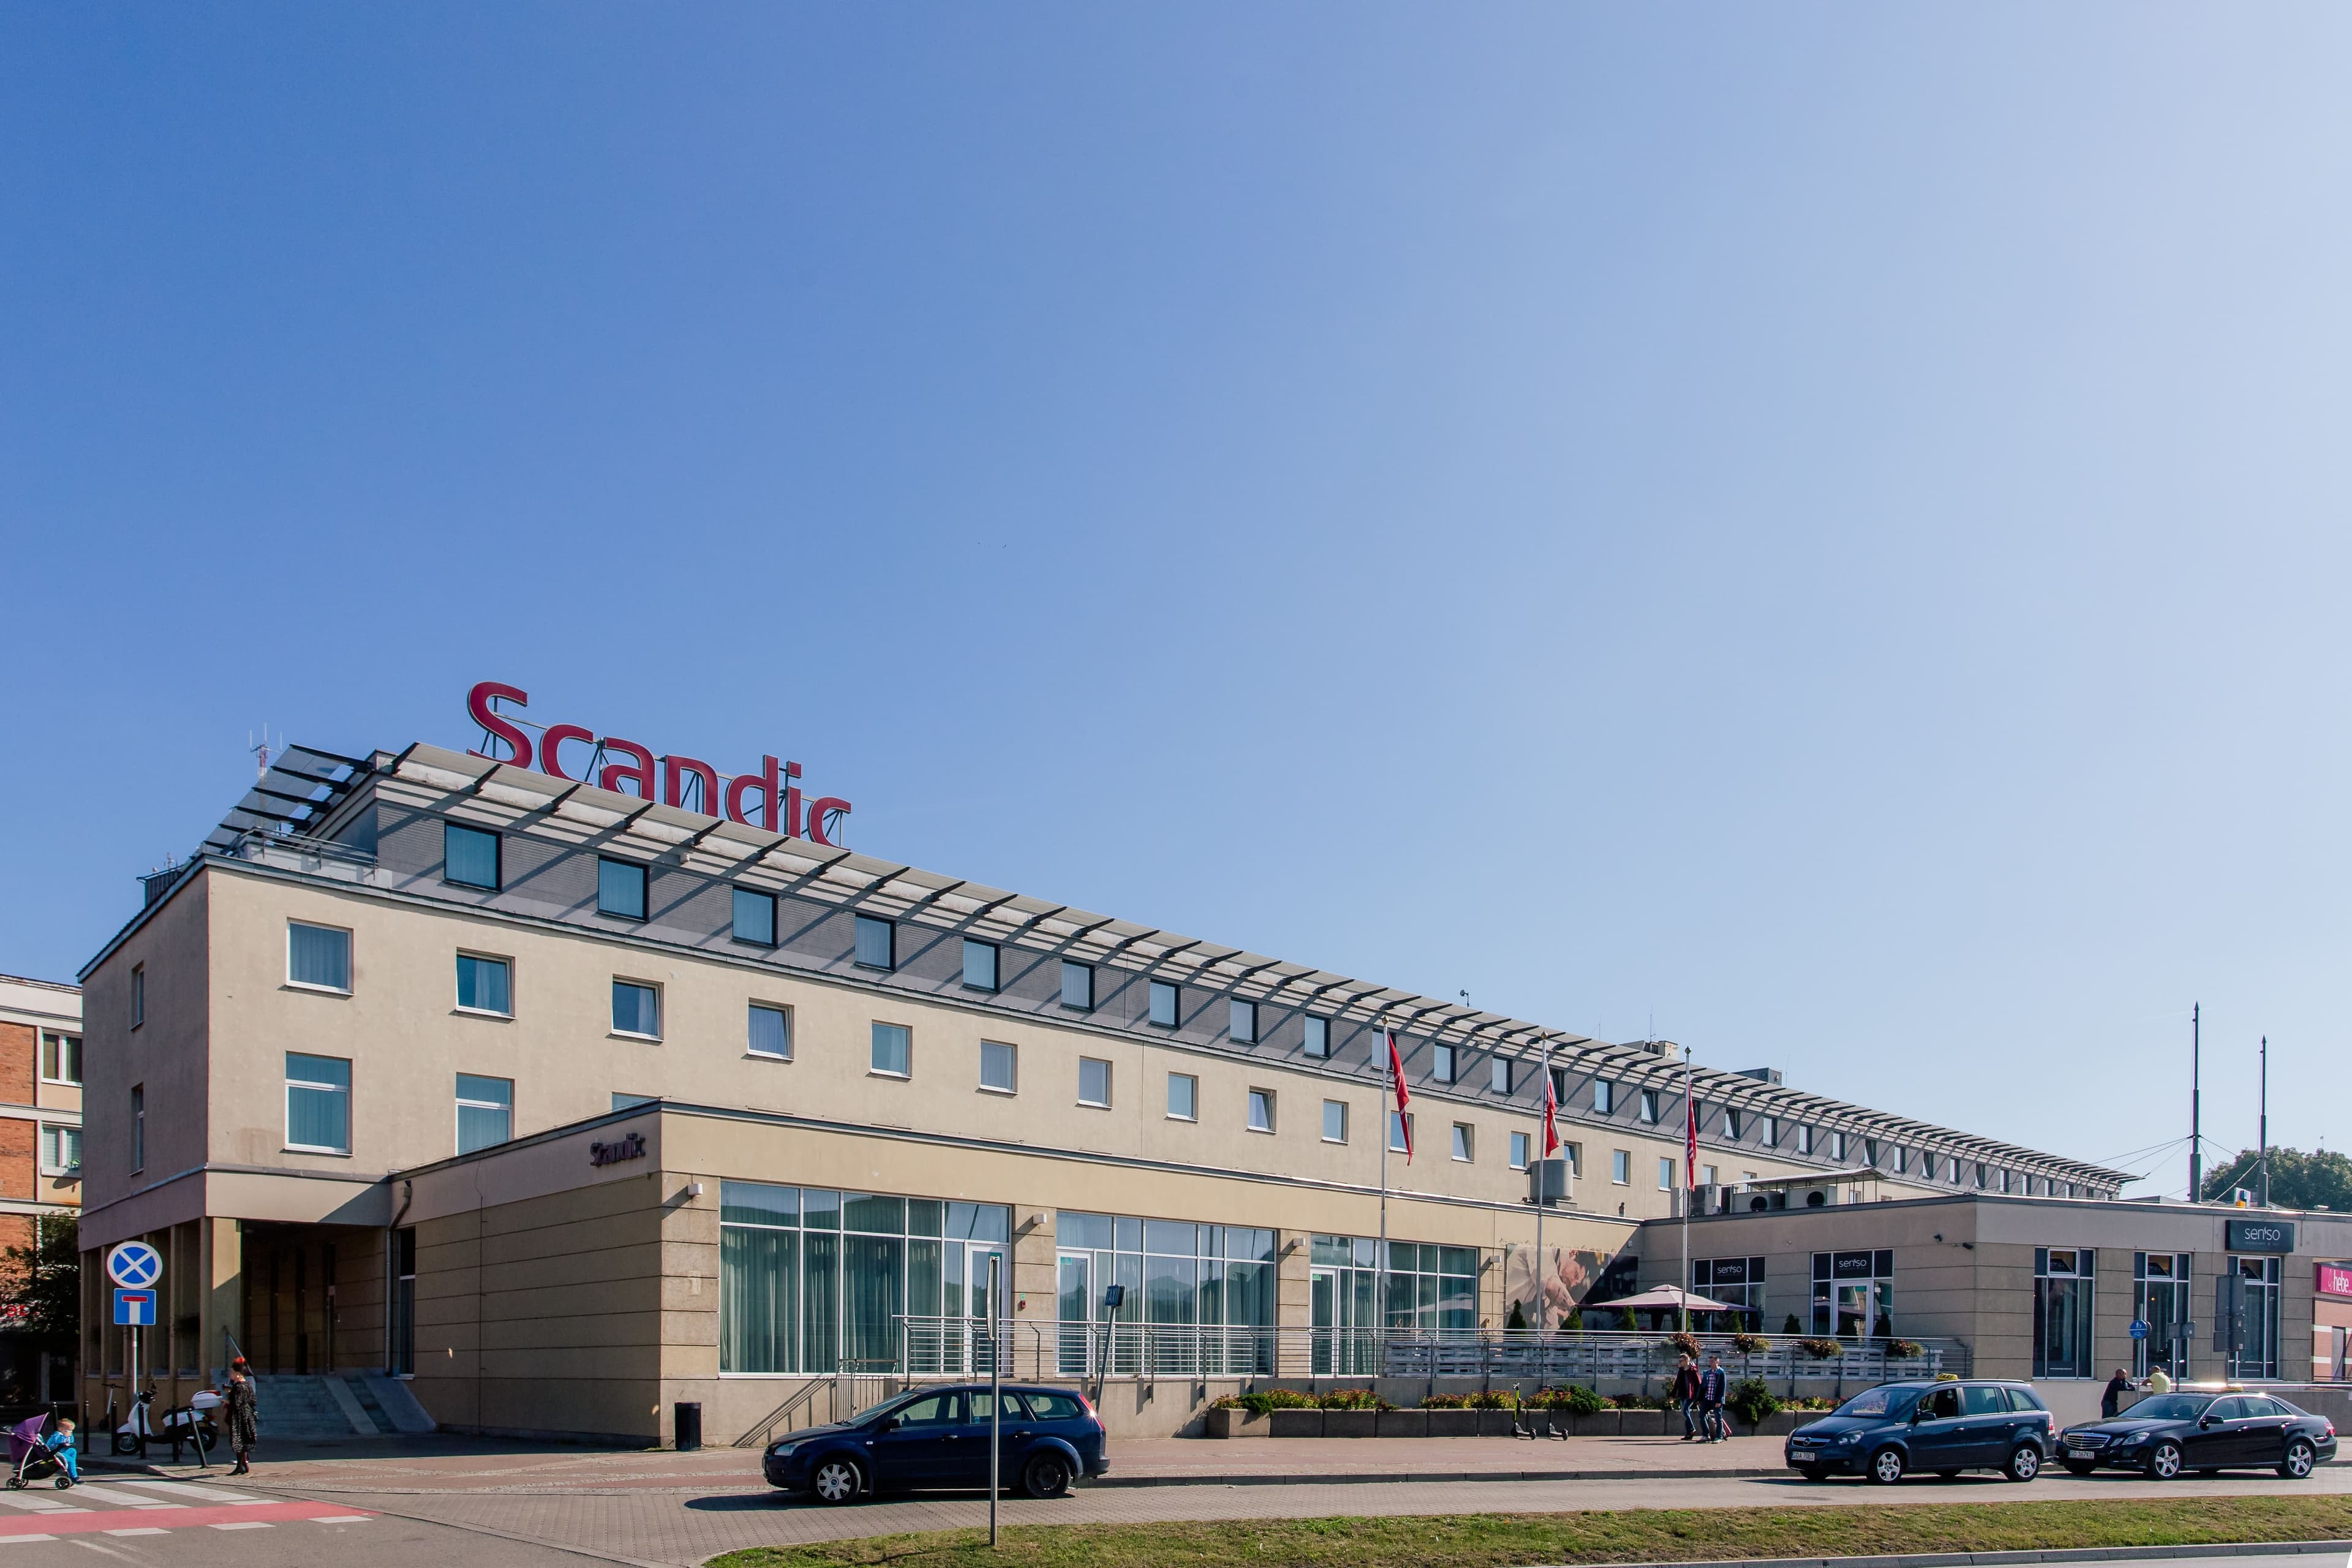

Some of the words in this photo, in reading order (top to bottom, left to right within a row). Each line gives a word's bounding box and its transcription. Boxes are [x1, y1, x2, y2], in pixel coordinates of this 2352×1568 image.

[467, 680, 851, 851] Scandic
[590, 1133, 646, 1167] Scandic
[1106, 1287, 1118, 1303] TAXI
[2334, 1269, 2349, 1293] hebe
